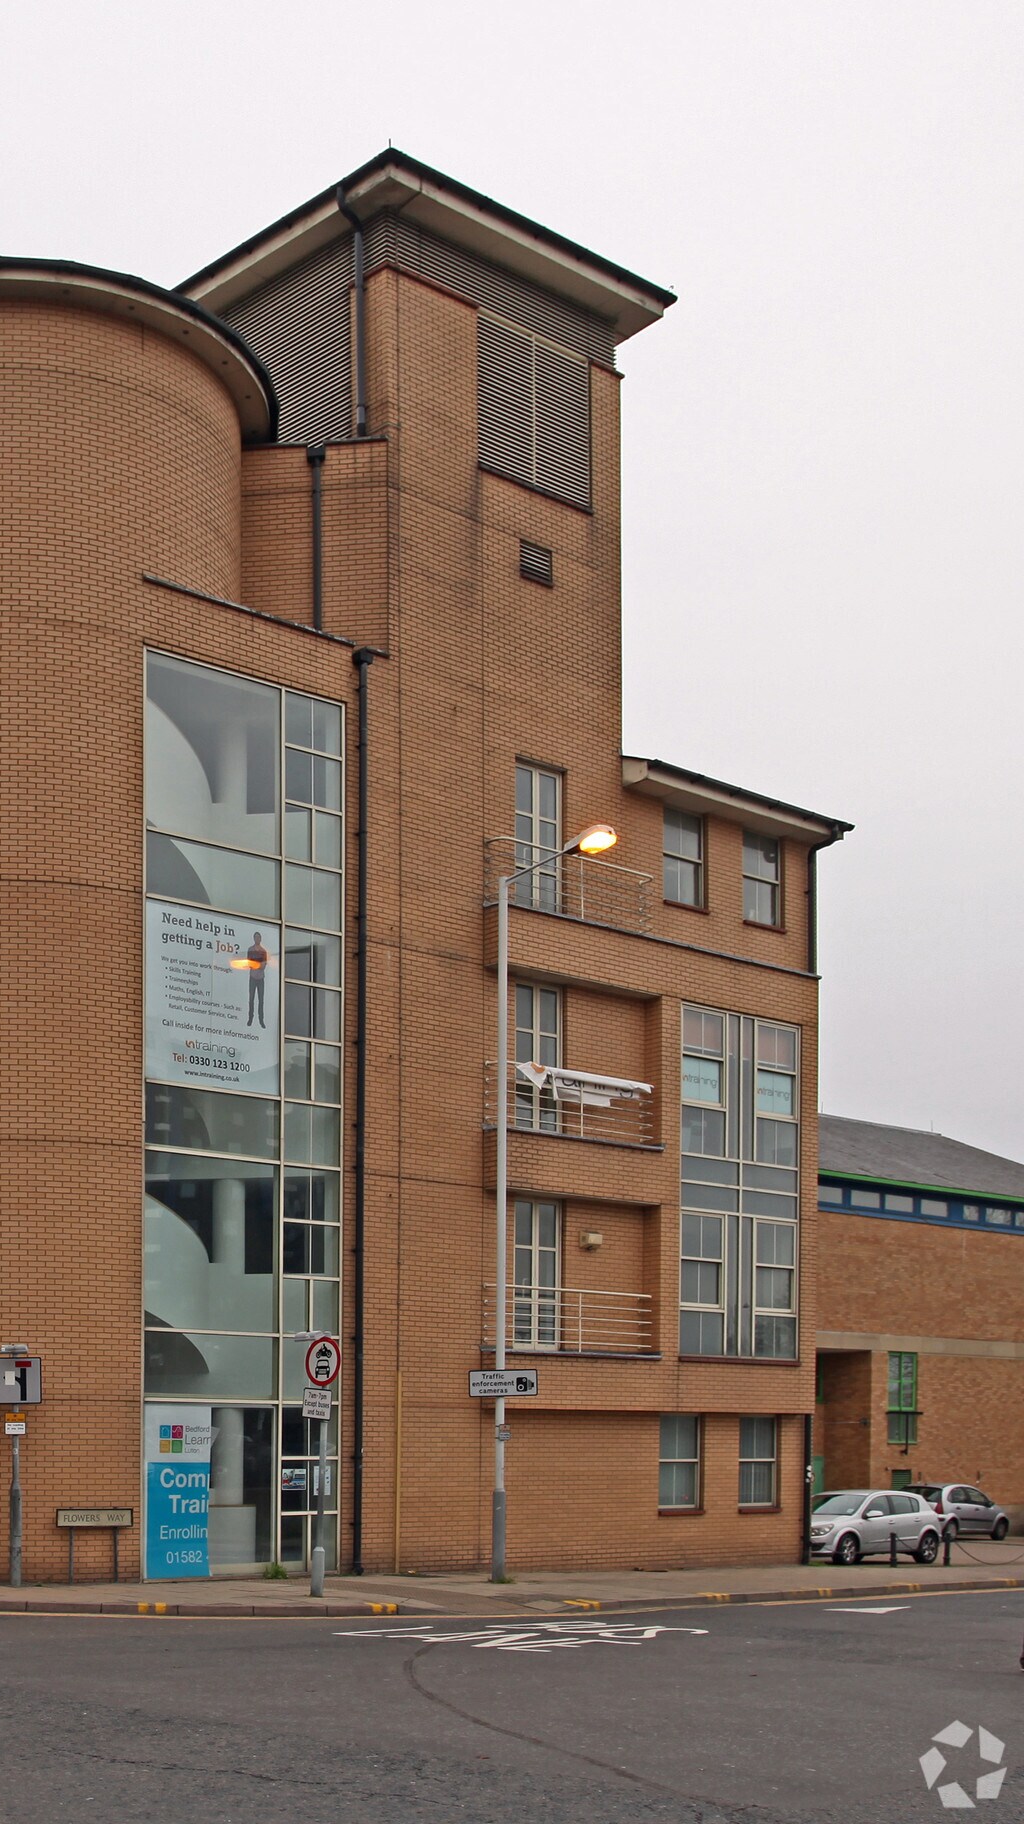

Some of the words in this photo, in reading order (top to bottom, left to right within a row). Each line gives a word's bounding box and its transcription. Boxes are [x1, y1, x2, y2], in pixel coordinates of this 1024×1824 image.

[162, 912, 193, 928] Need
[196, 919, 221, 936] help
[224, 925, 235, 936] in
[162, 932, 203, 950] getting
[206, 940, 213, 949] a
[216, 940, 240, 954] Job?
[182, 969, 202, 978] Training
[169, 985, 185, 993] Maths,
[186, 988, 205, 996] English,
[169, 994, 201, 1005] Employability
[202, 1000, 220, 1008] courses
[169, 1003, 183, 1011] Retail,
[184, 1006, 207, 1015] Customer
[162, 1019, 174, 1027] Call
[175, 1020, 194, 1030] inside
[195, 1024, 204, 1032] for
[224, 1029, 259, 1041] information
[172, 1053, 187, 1063] Tel:
[189, 1055, 210, 1066] 0330
[213, 1059, 228, 1069] 123
[230, 1062, 250, 1072] 1200
[184, 1070, 240, 1082] www.intraining.co.uk
[185, 1425, 210, 1433] Bedford
[169, 1494, 208, 1514] Trai
[63, 1514, 101, 1523] FLOWERS
[107, 1514, 126, 1522] WAY
[166, 1551, 203, 1564] 01582
